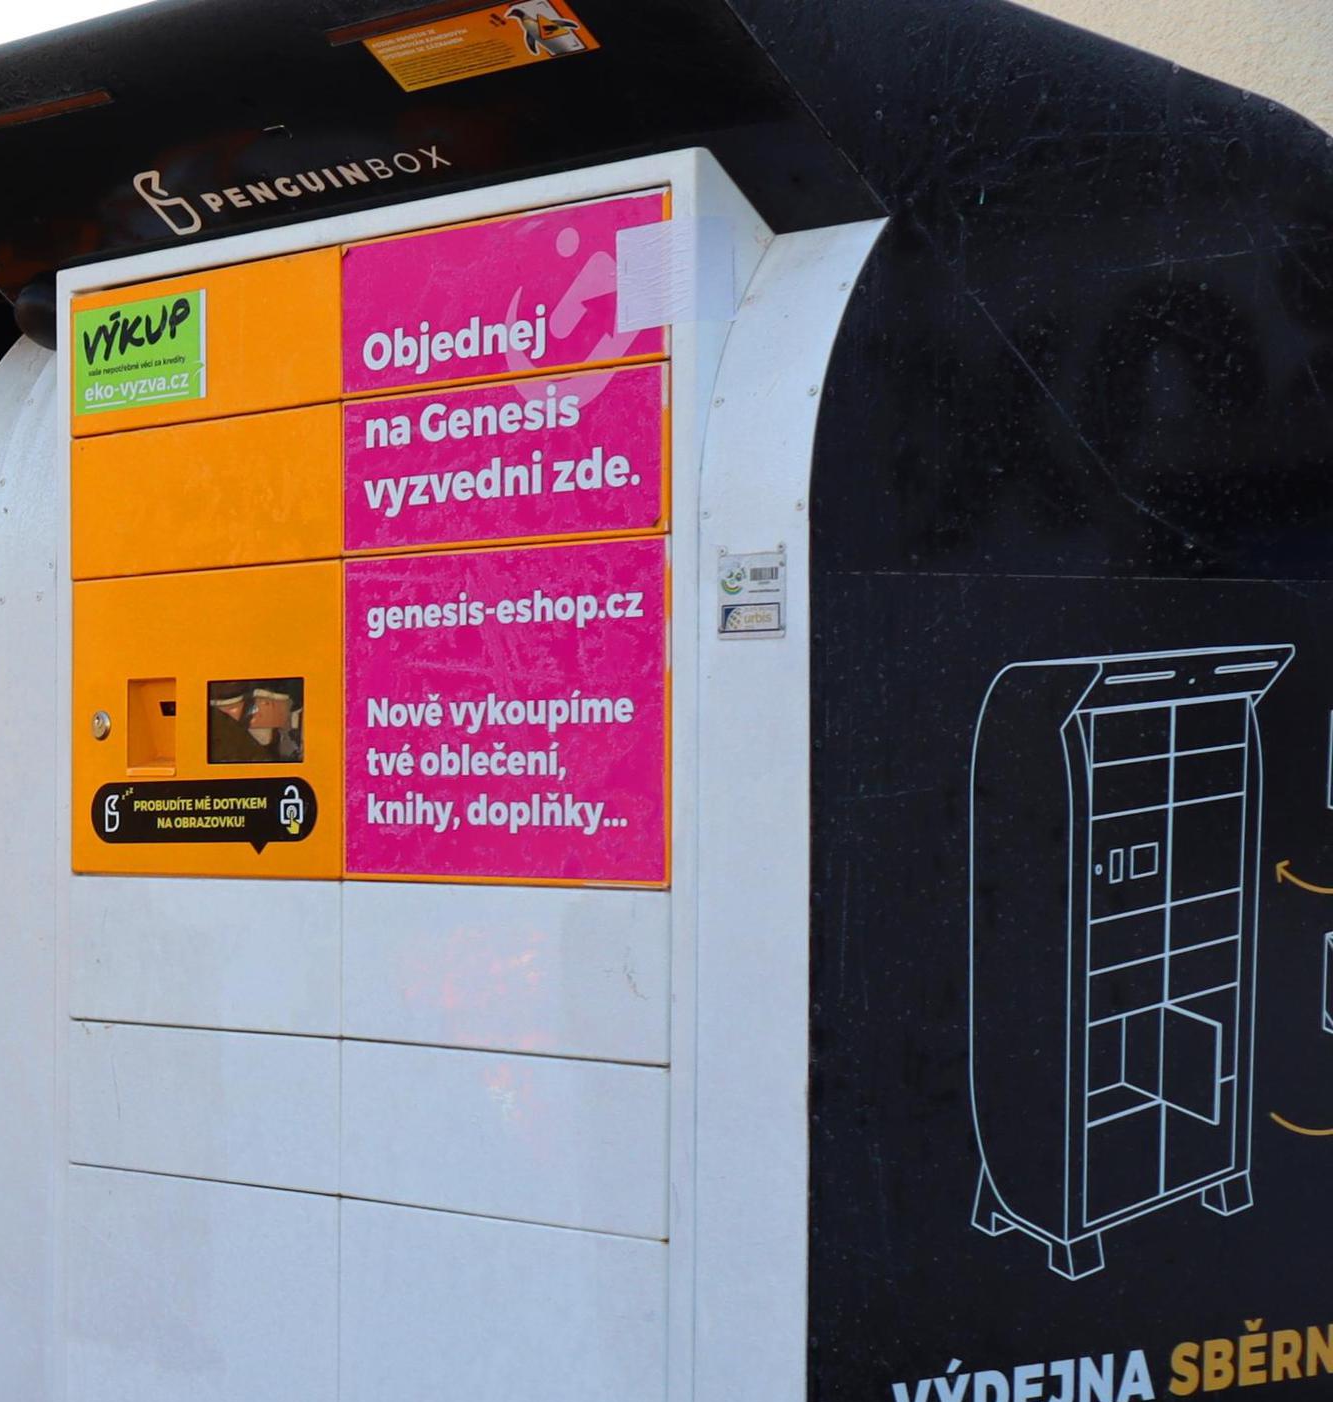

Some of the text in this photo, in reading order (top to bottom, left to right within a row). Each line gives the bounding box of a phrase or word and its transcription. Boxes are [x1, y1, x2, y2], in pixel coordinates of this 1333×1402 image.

[201, 145, 452, 214] PENGUINBOX
[83, 298, 191, 365] VÝKUP
[362, 304, 546, 376] Objednej
[84, 372, 189, 402] eko-vyzva.cz
[364, 384, 580, 448] na Genesis
[363, 445, 640, 516] vyzvedni zde.
[367, 588, 644, 640] genesis-eshop.cz
[367, 690, 634, 735] Nově vykoupíme
[367, 743, 567, 782] tvé oblečení,
[133, 796, 267, 812] PROBUDÍTE MĚ DOTYKEM
[157, 815, 245, 829] NA OBRAZOVKU!
[367, 792, 628, 837] knihy, doplňky...
